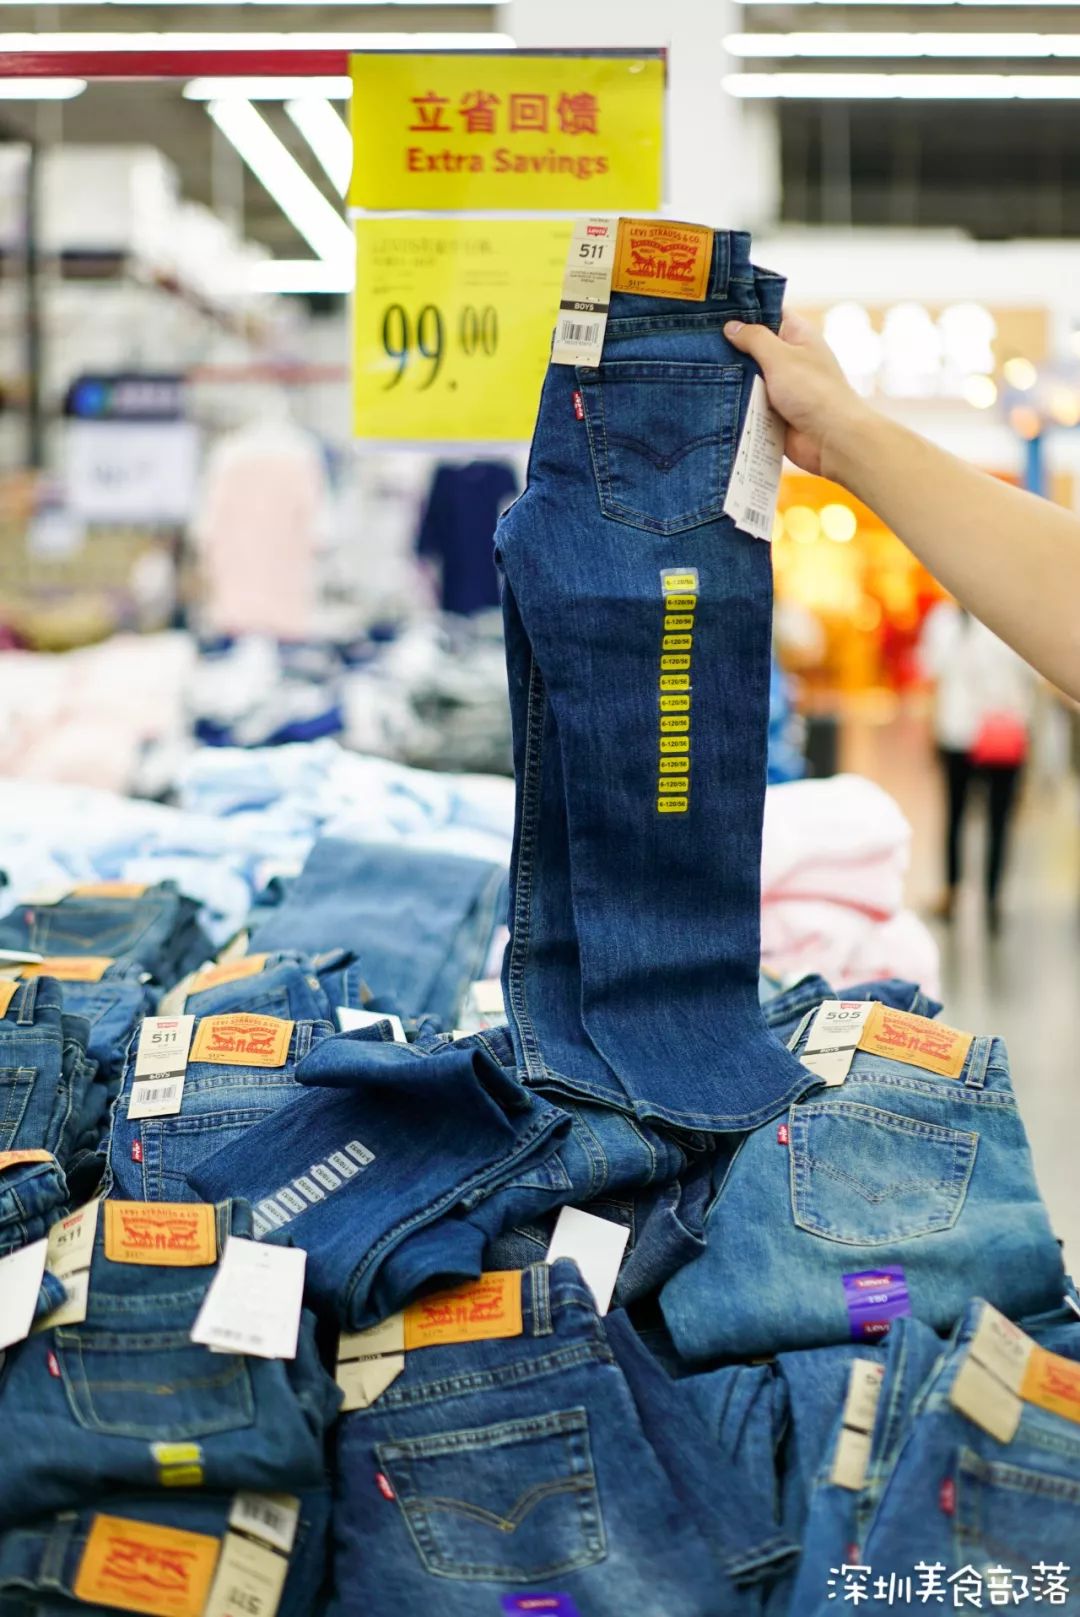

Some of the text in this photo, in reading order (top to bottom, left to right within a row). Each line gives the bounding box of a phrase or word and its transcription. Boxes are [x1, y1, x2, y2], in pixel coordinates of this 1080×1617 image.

[407, 89, 601, 136] 立省回馈
[406, 148, 609, 179] Extra Savings
[579, 244, 604, 258] 511
[574, 302, 595, 311] BOYS
[152, 1032, 177, 1043] 511
